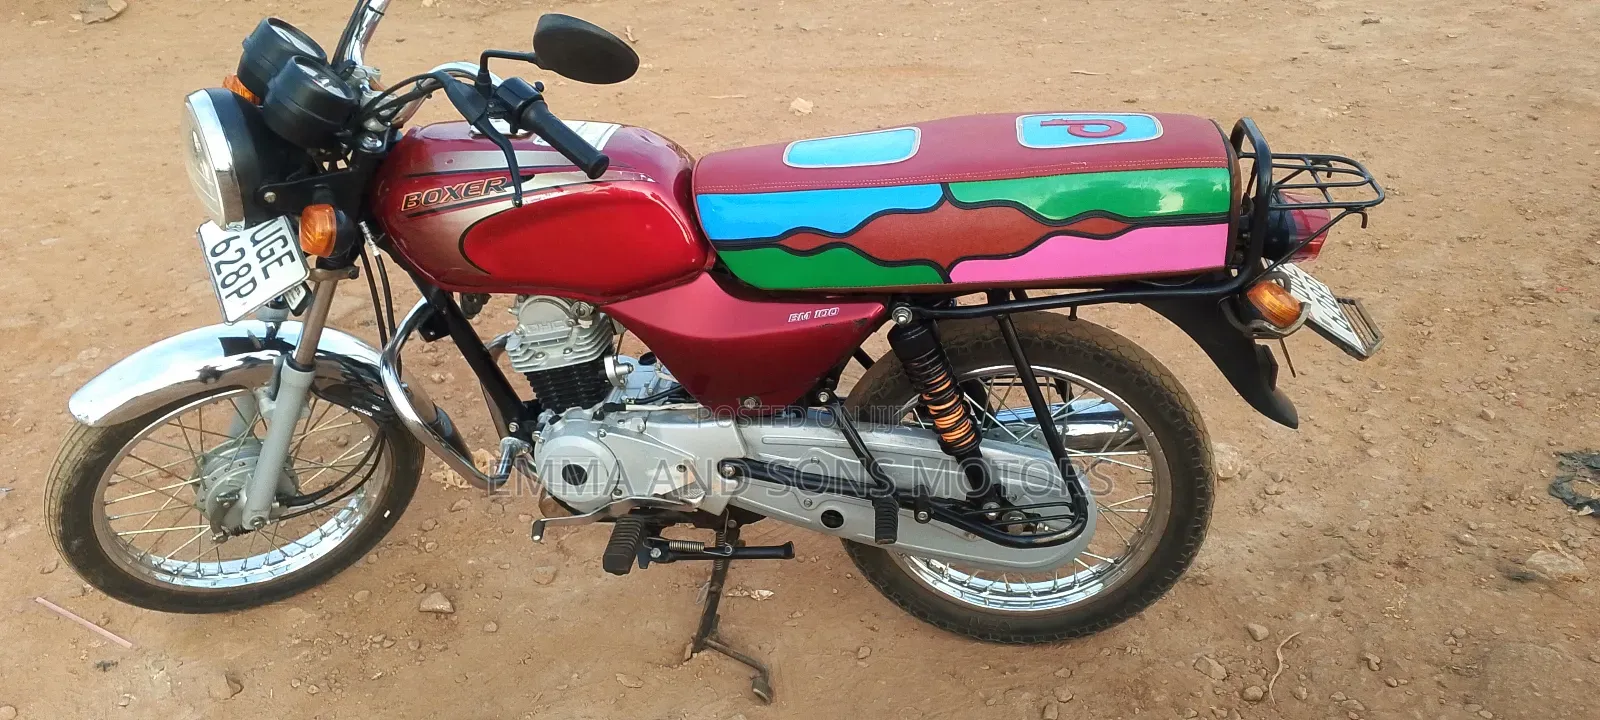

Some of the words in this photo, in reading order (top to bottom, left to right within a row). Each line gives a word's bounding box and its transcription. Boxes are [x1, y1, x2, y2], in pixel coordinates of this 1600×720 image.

[401, 176, 508, 211] BOXER
[210, 235, 258, 299] 628P
[249, 219, 296, 280] UGE
[788, 311, 811, 322] BM
[814, 307, 839, 318] 100
